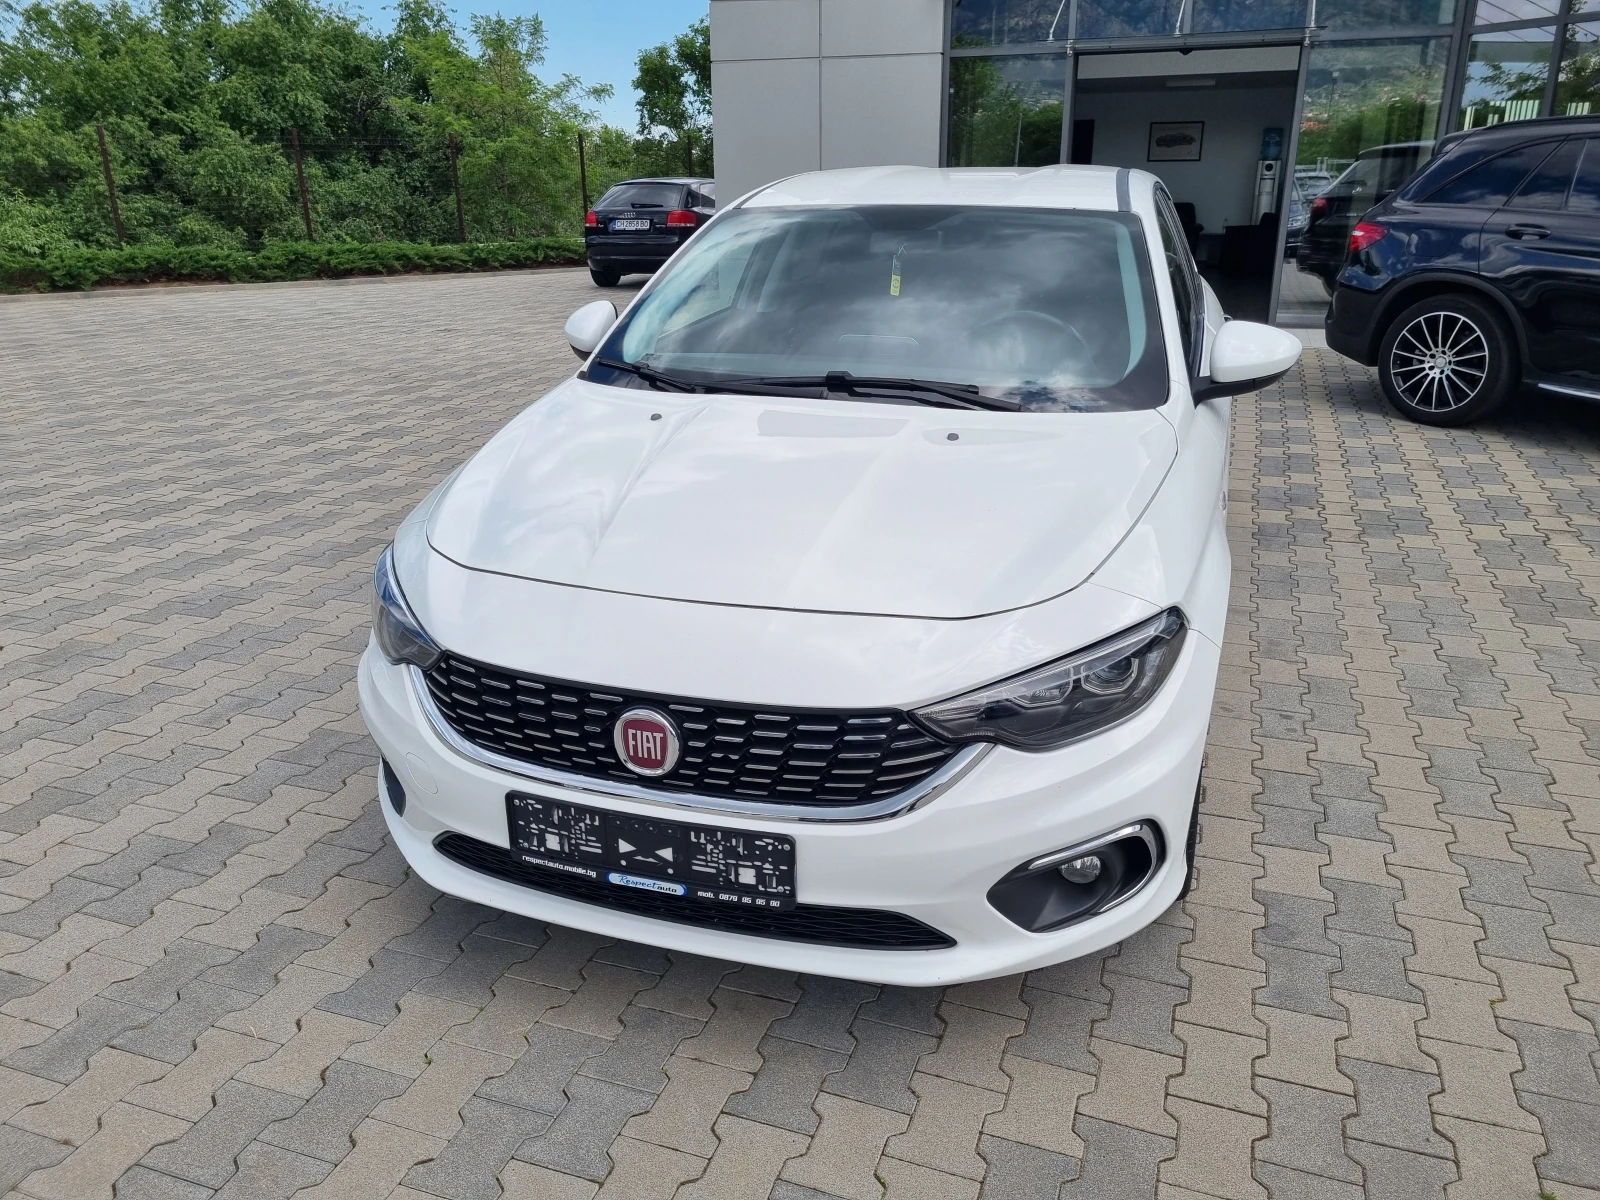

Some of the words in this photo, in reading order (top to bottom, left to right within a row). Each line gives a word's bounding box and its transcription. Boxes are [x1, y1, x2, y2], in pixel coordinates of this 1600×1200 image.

[628, 728, 664, 760] FIAT
[697, 890, 715, 899] mob.
[718, 893, 738, 902] 0879
